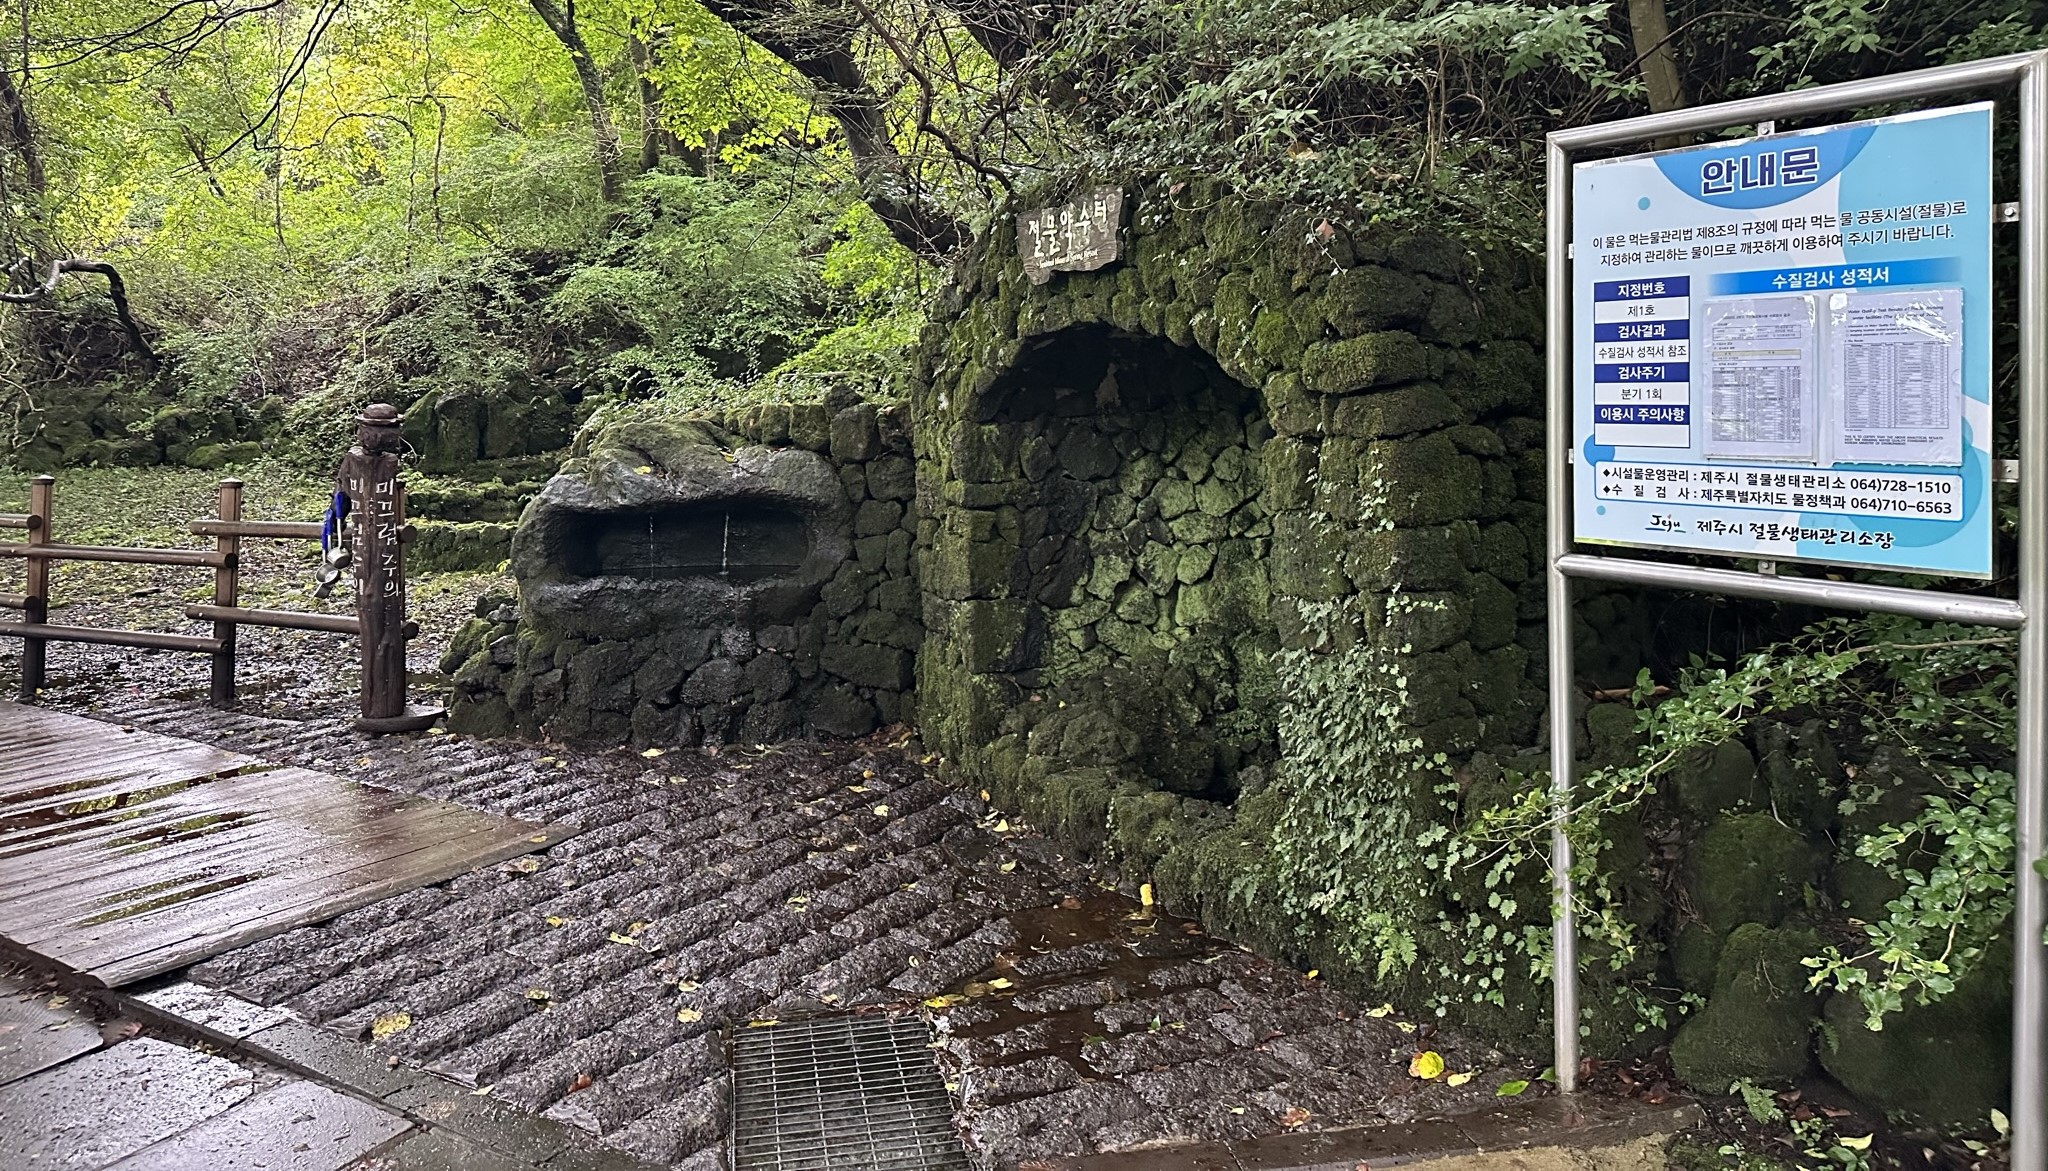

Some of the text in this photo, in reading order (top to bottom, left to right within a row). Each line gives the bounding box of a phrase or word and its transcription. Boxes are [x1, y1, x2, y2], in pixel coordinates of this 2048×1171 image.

[1701, 146, 1820, 196] 안내문
[1592, 201, 1967, 249] 이 물은 먹는물관리법 제8조의 규정에 따라 먹는 물 공동시설(절물)로
[1601, 224, 1954, 266] 지정하여 관리하는 물이므로 깨끗하게 이용하여 주시기 바랍니다.
[1772, 267, 1889, 289] 수질검사 성적서
[1617, 282, 1666, 297] 지정번호
[1627, 305, 1656, 317] 제1호
[1617, 324, 1666, 338] 검사결과
[1598, 344, 1687, 359] 수질검사 성적서 참조
[1618, 366, 1665, 380] 검사주기
[1621, 388, 1662, 400] 분기 1회
[1600, 408, 1685, 422] 이용시 주의사항
[1611, 467, 1689, 482] 시설물운영관리
[1700, 471, 1739, 485] 제주시
[1746, 472, 1846, 489] 절물생태관리소
[1850, 478, 1951, 494] 064)728-1510
[1700, 488, 1788, 505] 제주특별자치도
[1792, 493, 1846, 509] 물정책과
[1851, 497, 1952, 514] 064)710-6563
[1650, 514, 1681, 532] Jeju
[1697, 520, 1894, 549] 제주시 절물생태관리소장
